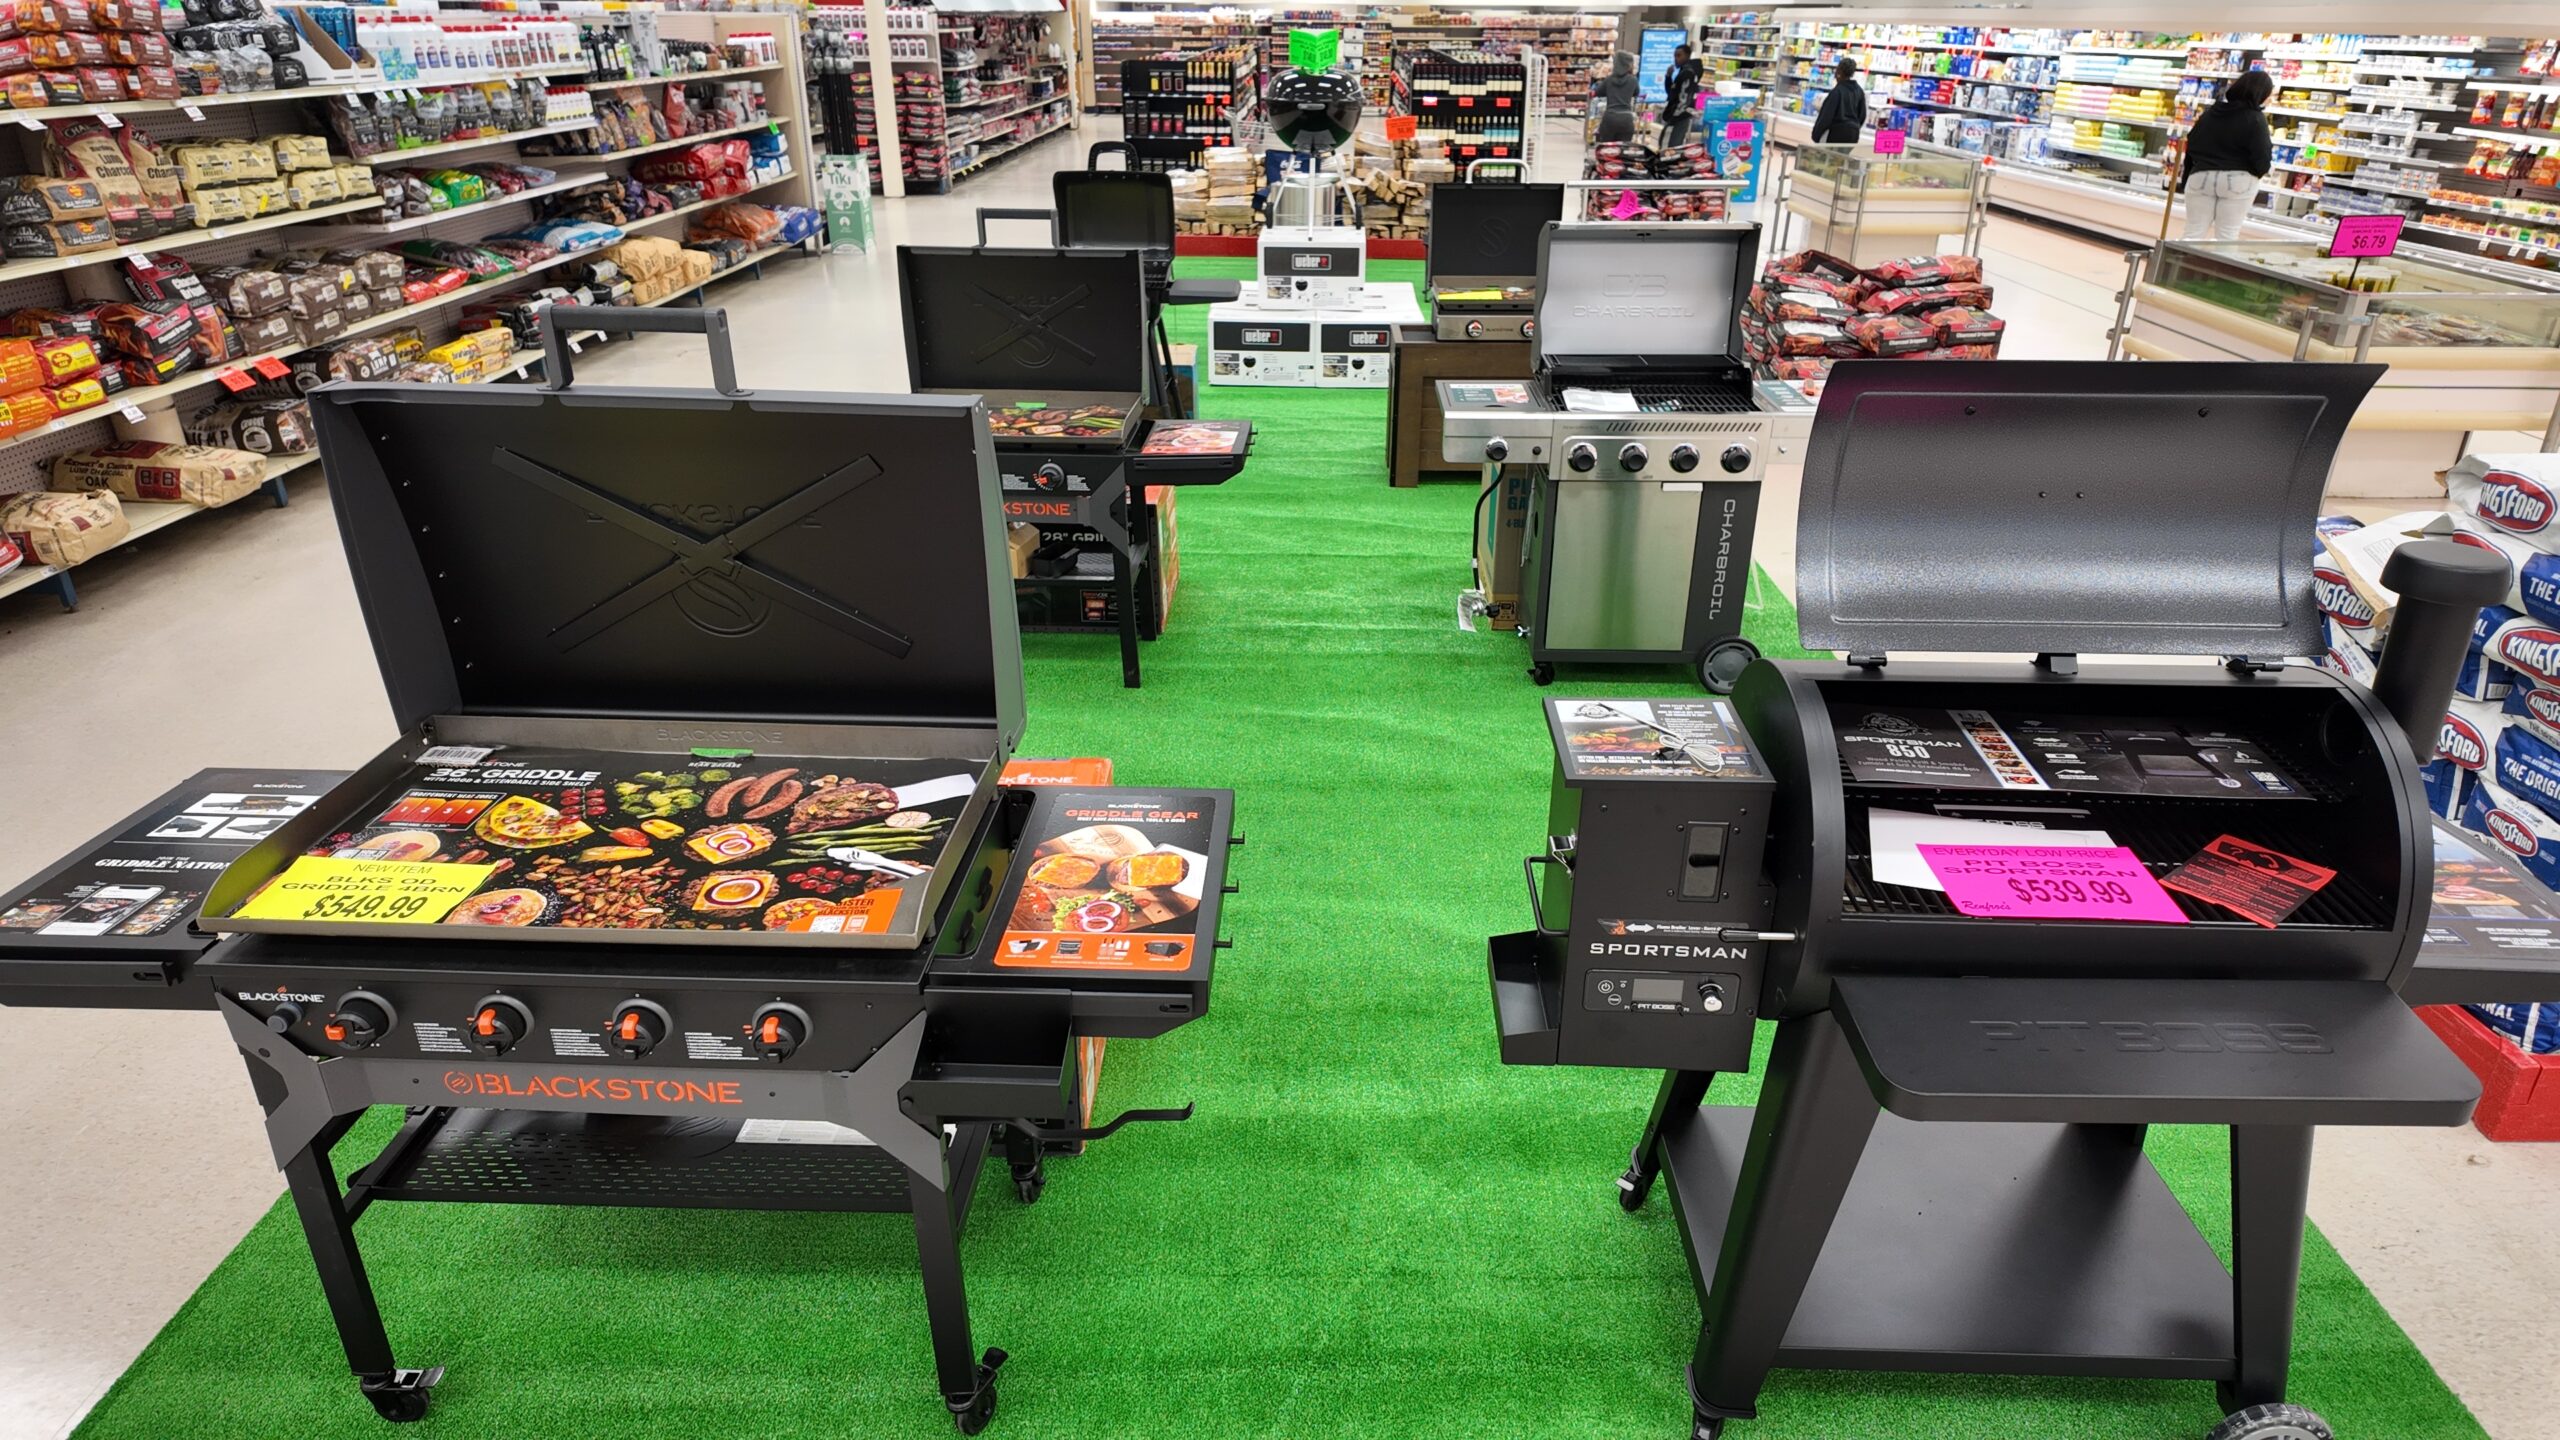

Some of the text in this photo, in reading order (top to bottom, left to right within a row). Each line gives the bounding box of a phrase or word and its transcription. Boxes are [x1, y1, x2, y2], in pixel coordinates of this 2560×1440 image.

[2352, 235, 2386, 250] $6.79
[1295, 255, 1321, 268] weber
[1571, 304, 1696, 318] CHARBROIL
[1244, 330, 1271, 343] weber
[1352, 331, 1378, 344] weber
[85, 476, 110, 488] OAK
[2481, 482, 2546, 523] INGSFORD
[1708, 498, 1737, 620] CHARBROIL
[2529, 577, 2556, 602] THE
[2313, 577, 2373, 621] INGSFORD
[656, 728, 784, 744] BLACKSTONE
[1844, 736, 1962, 748] SPORTSMAN
[2439, 723, 2481, 763] SFORD
[1885, 743, 1931, 759] 850
[430, 768, 602, 782] 36" GRIDDLE
[2503, 757, 2528, 782] THE
[483, 778, 540, 786] EXTENDABLE
[1065, 809, 1200, 819] GRIDDLE GEAR
[2488, 813, 2534, 852] KINGSFORD
[1933, 847, 2119, 859] EVERYDAY LOW PRICE
[94, 859, 169, 868] GRIDDLE
[353, 863, 433, 875] NEW ITEM
[1963, 859, 2105, 869] PIT BOSS
[1943, 866, 2139, 878] SPORTSMAN
[326, 875, 437, 886] BLKS OD
[282, 882, 467, 894] GRIDDLE 4BRN
[2006, 877, 2134, 905] $539.99
[303, 894, 429, 920] $549.99
[1589, 942, 1748, 960] SPORTSMAN
[238, 991, 325, 1003] BLACKSTONE
[1969, 1020, 2335, 1054] PIT BOSS
[475, 1072, 744, 1105] BLACKSTONE
